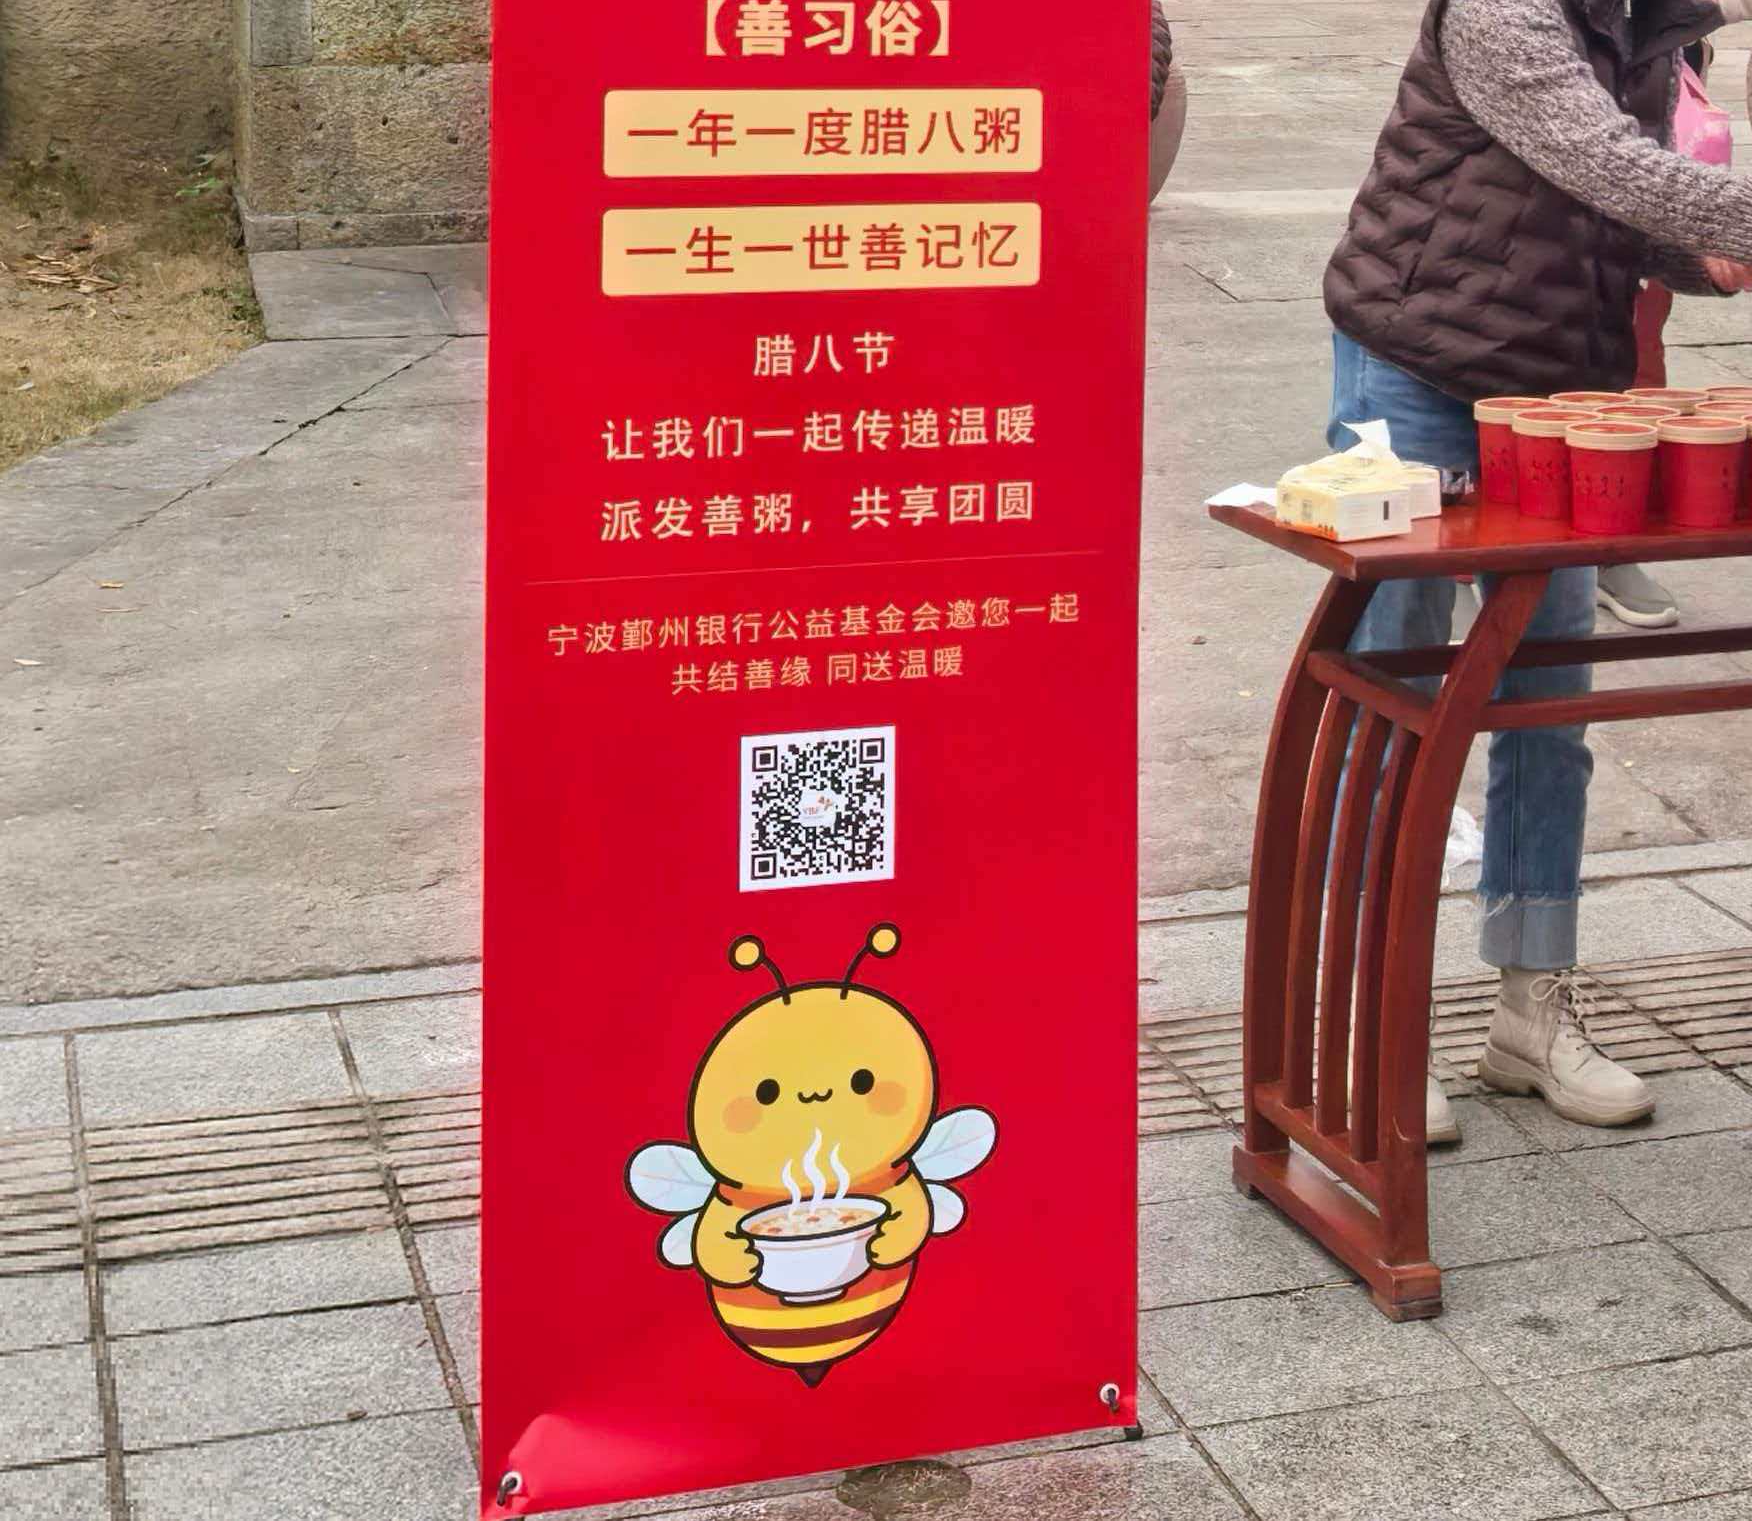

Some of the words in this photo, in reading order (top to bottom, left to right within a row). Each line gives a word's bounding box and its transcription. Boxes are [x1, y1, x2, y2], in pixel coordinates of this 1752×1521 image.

[627, 107, 1021, 158] 一年一度腊八粥
[625, 221, 1018, 274] 一生一世善记忆
[753, 331, 894, 376] 腊八节
[601, 404, 1035, 461] 让我们一起传递温暖
[547, 593, 1080, 657] 宁波鄞州银行公益基金会邀您一起
[671, 656, 812, 696] 共结善缘
[827, 645, 963, 684] 同送温暖
